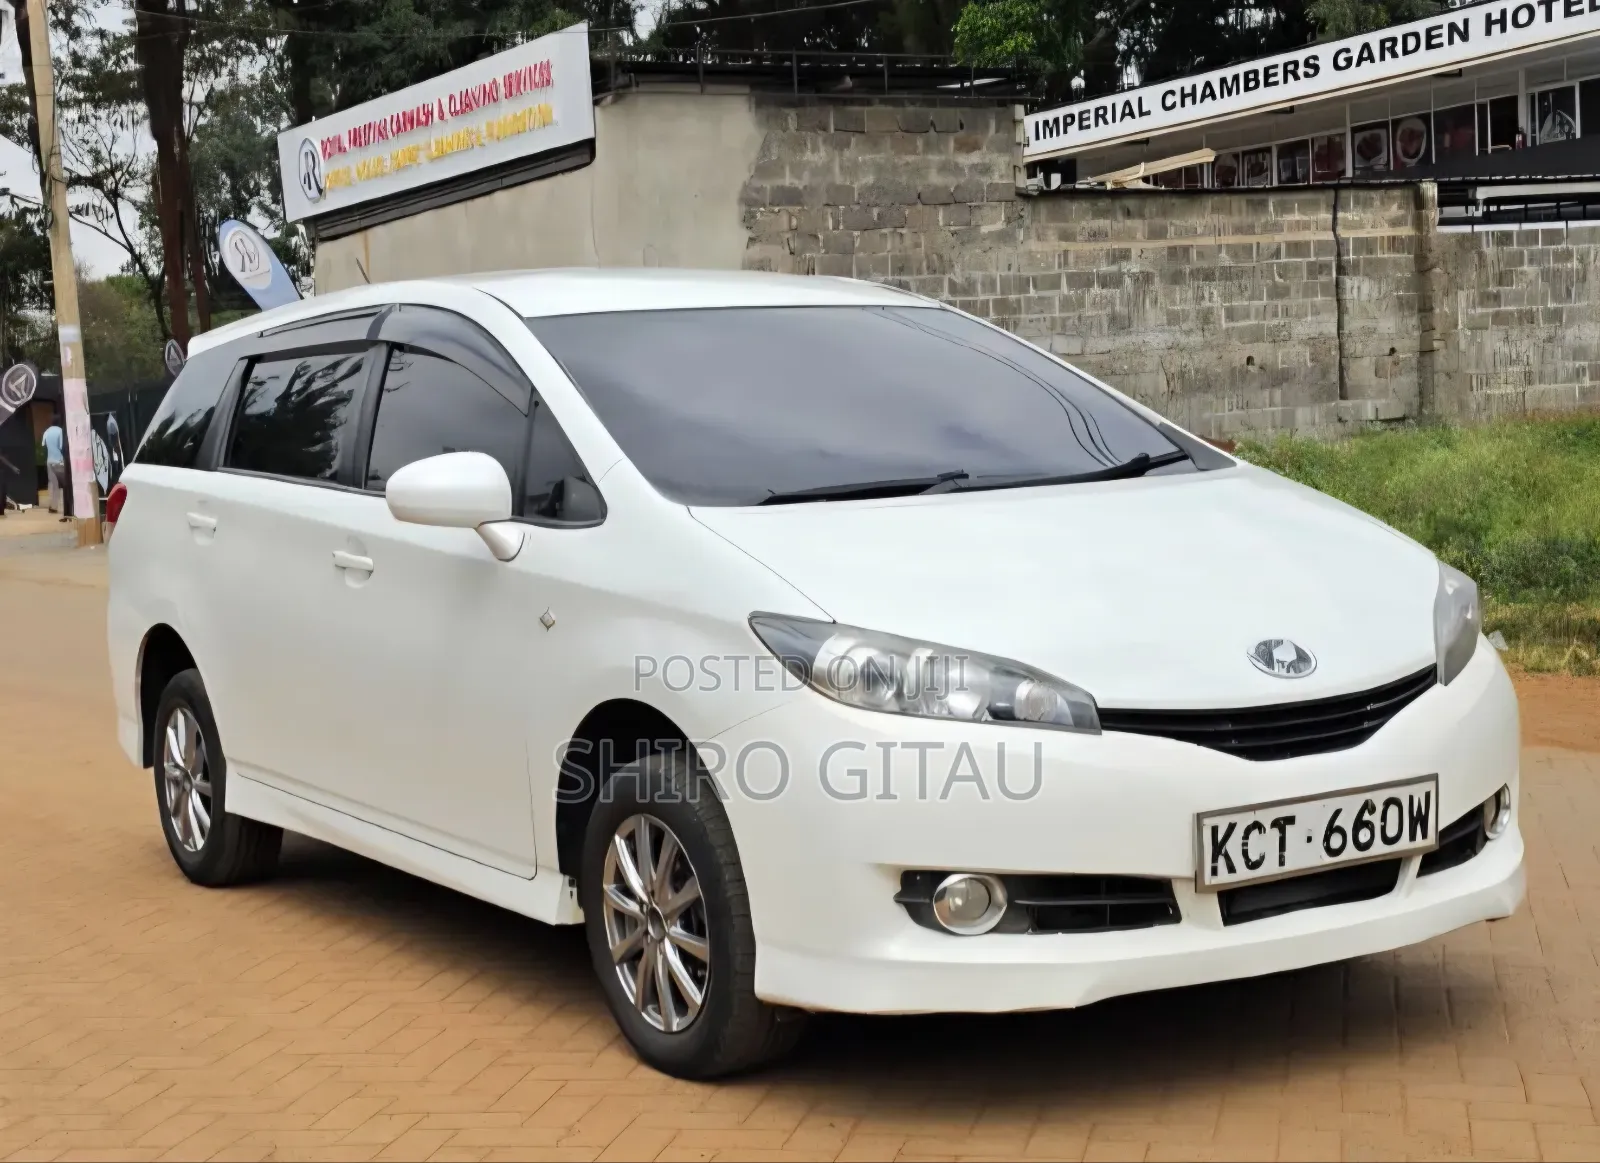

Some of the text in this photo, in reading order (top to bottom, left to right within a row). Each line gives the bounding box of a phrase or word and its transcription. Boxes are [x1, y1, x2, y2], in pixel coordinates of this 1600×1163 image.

[1034, 96, 1151, 142] IMPERIAL
[1161, 54, 1321, 112] CHAMBERS
[1332, 17, 1470, 72] GARDEN
[1210, 790, 1432, 877] KCT 660W
